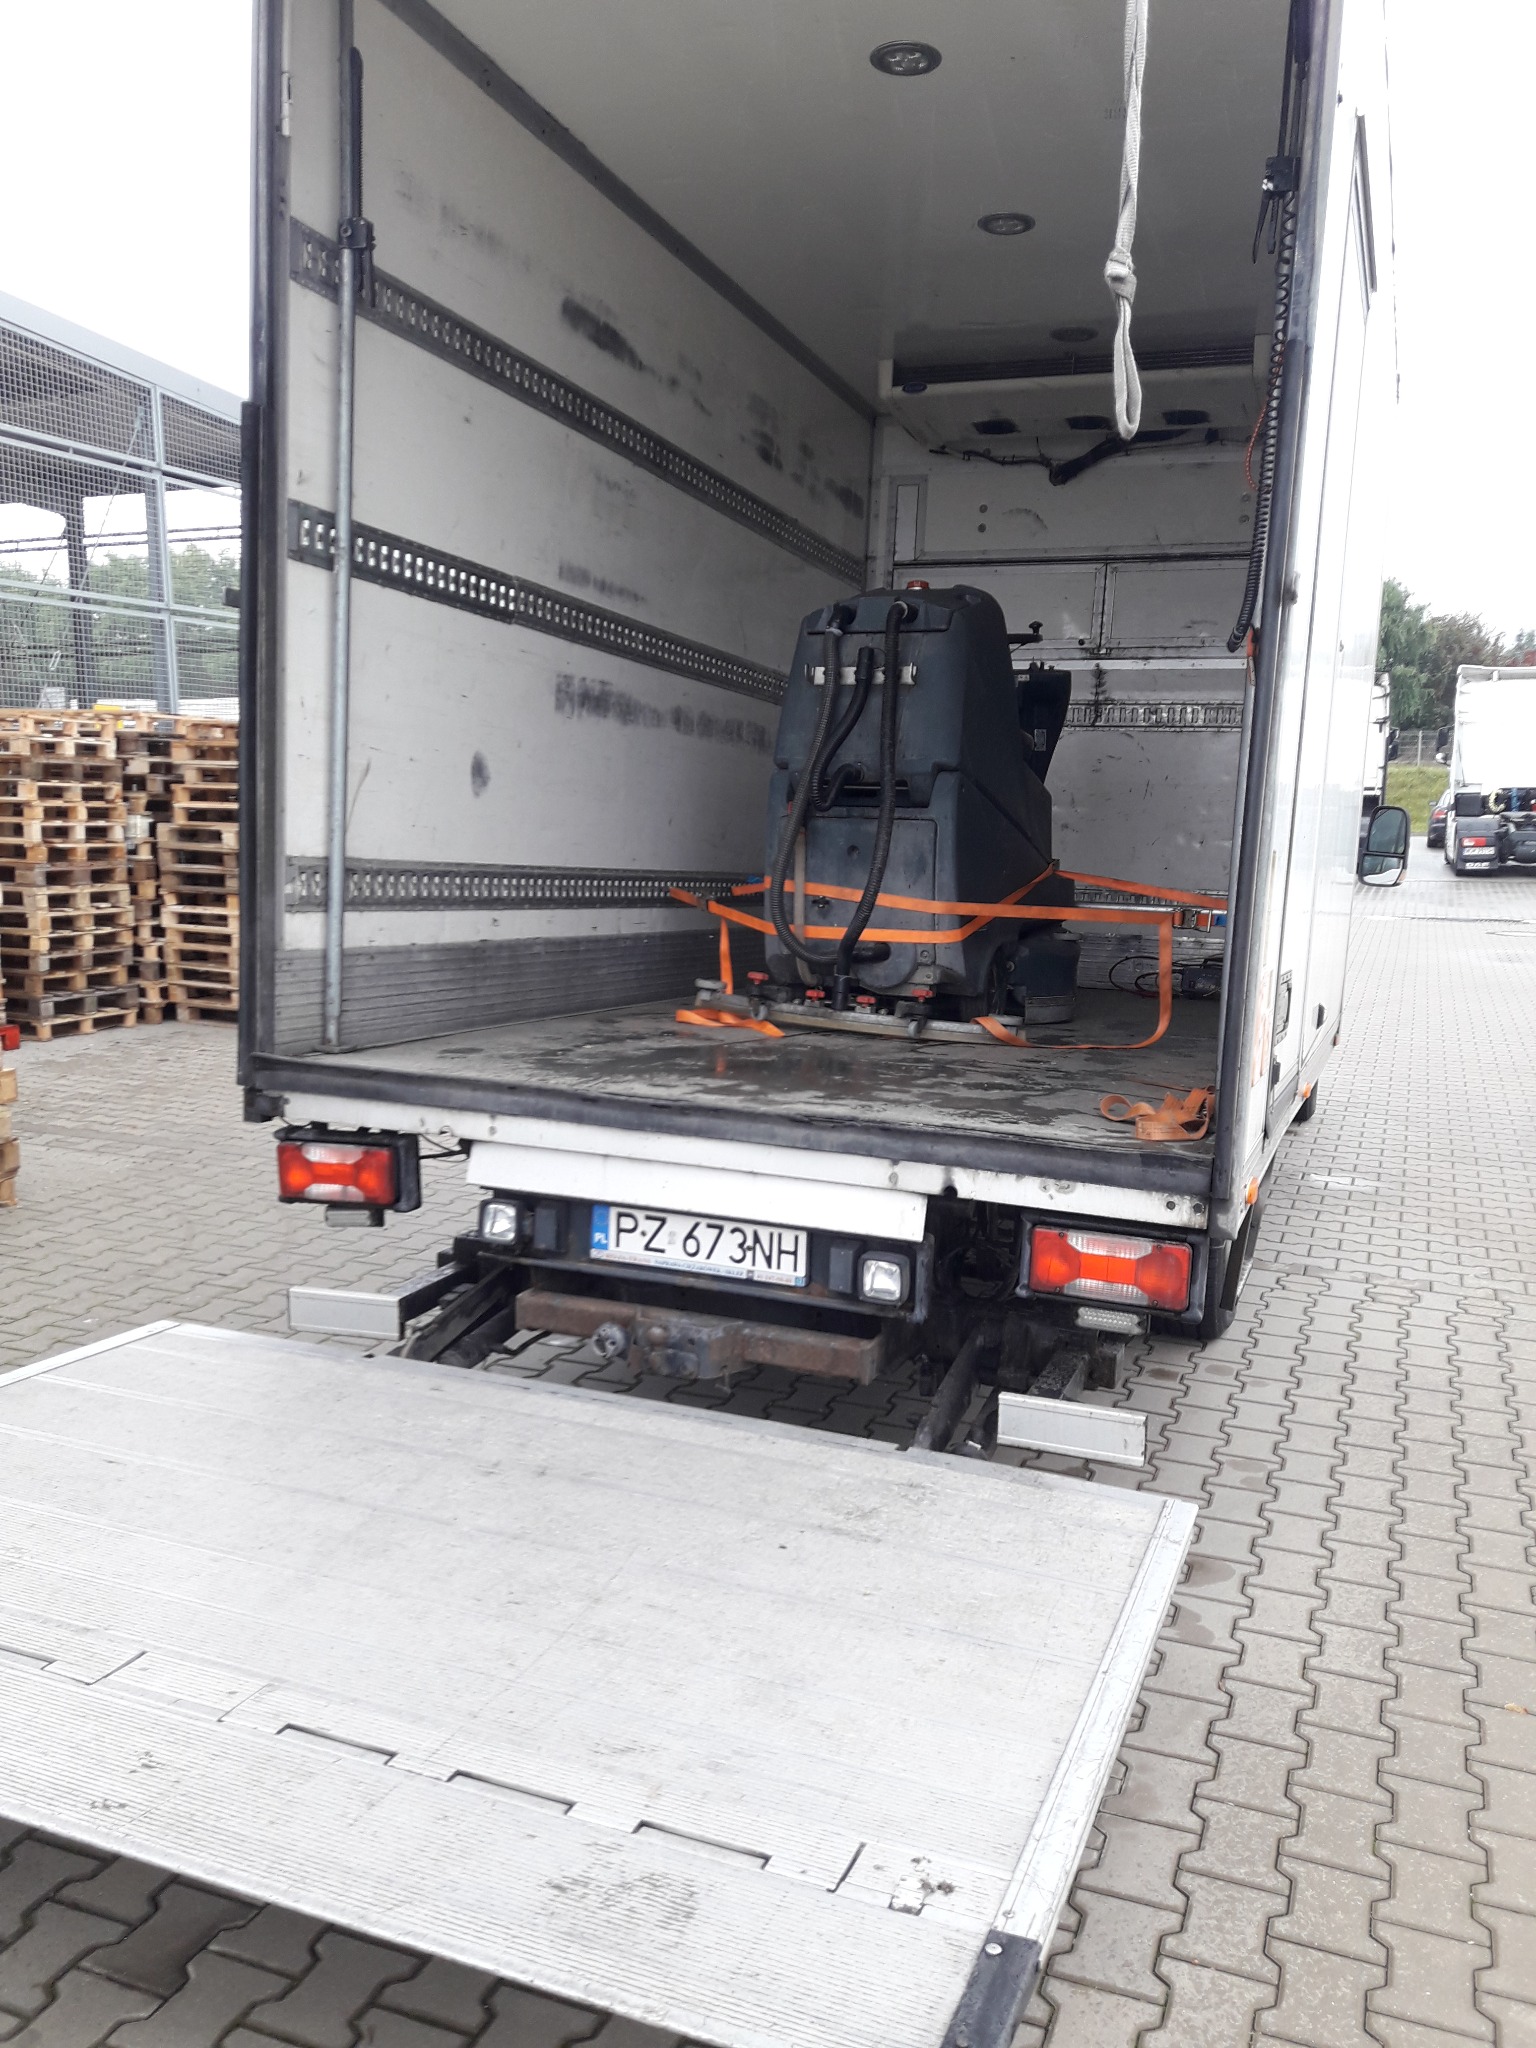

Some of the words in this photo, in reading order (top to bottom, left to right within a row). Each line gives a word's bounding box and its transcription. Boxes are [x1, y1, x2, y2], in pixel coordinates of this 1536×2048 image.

[593, 1232, 608, 1244] PL
[616, 1212, 667, 1253] PZ
[682, 1221, 799, 1272] 673NH
